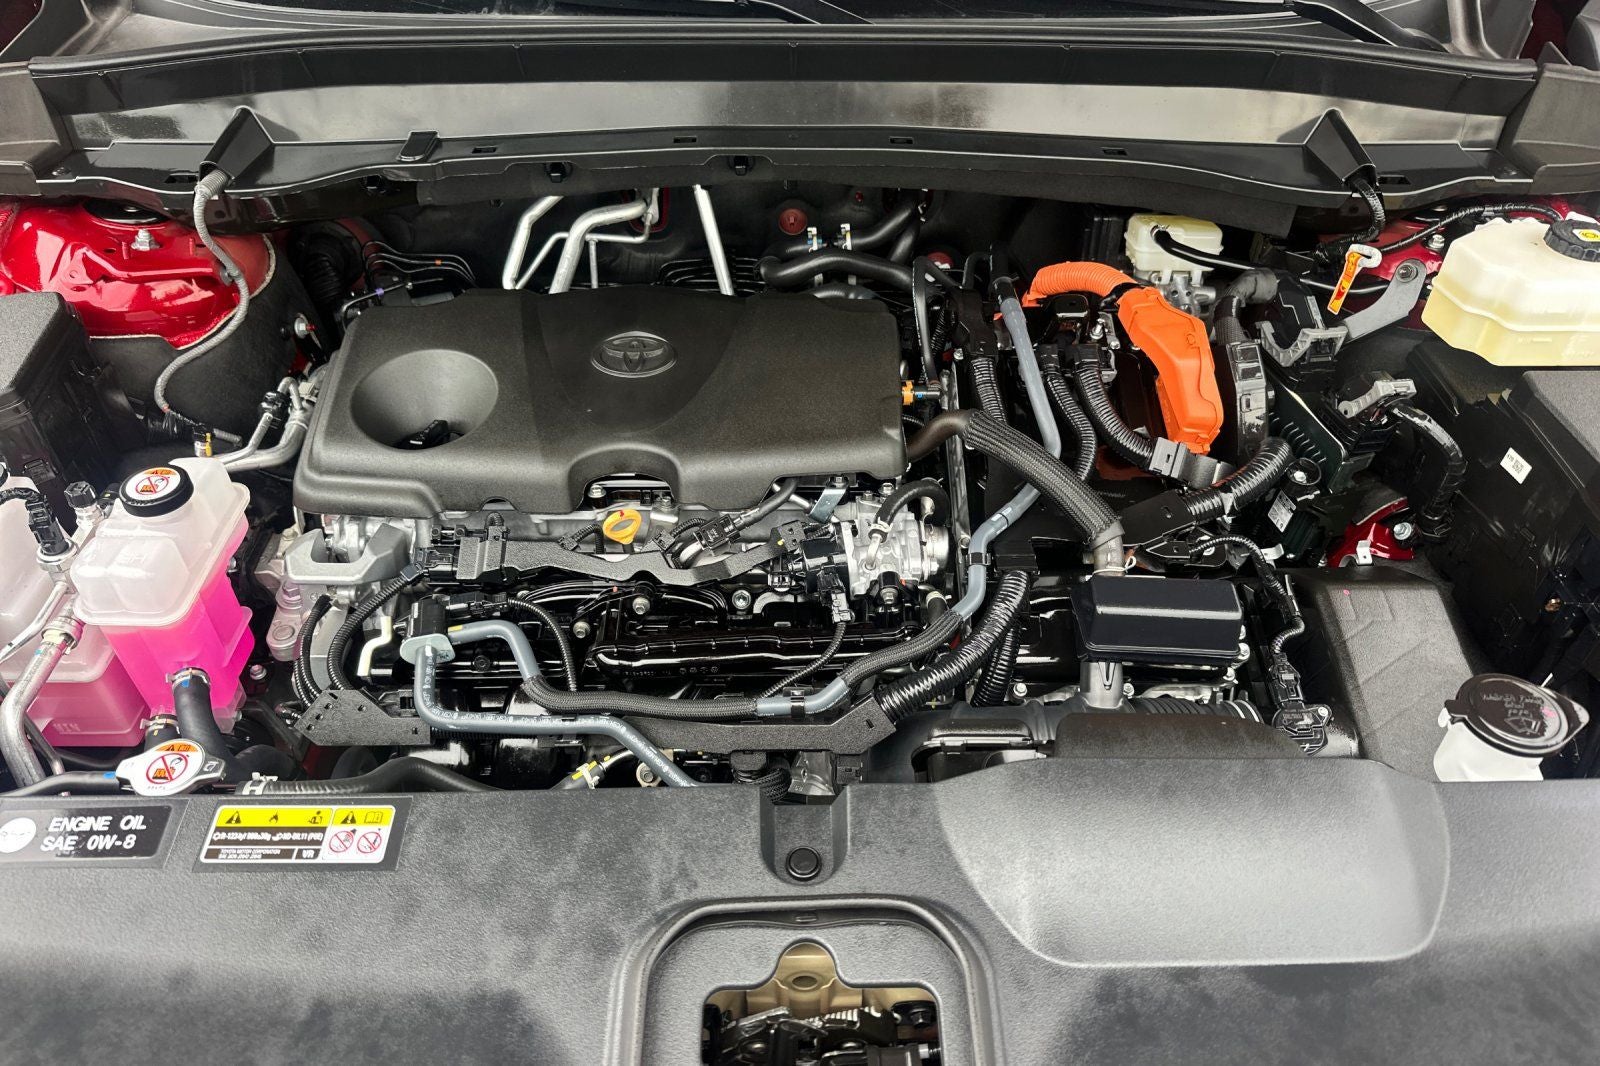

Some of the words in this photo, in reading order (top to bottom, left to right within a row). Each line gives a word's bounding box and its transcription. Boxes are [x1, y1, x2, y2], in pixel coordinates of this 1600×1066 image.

[48, 816, 112, 832] ENGINE
[120, 815, 146, 830] OIL
[40, 835, 78, 851] SAE
[86, 834, 137, 850] 0W-8
